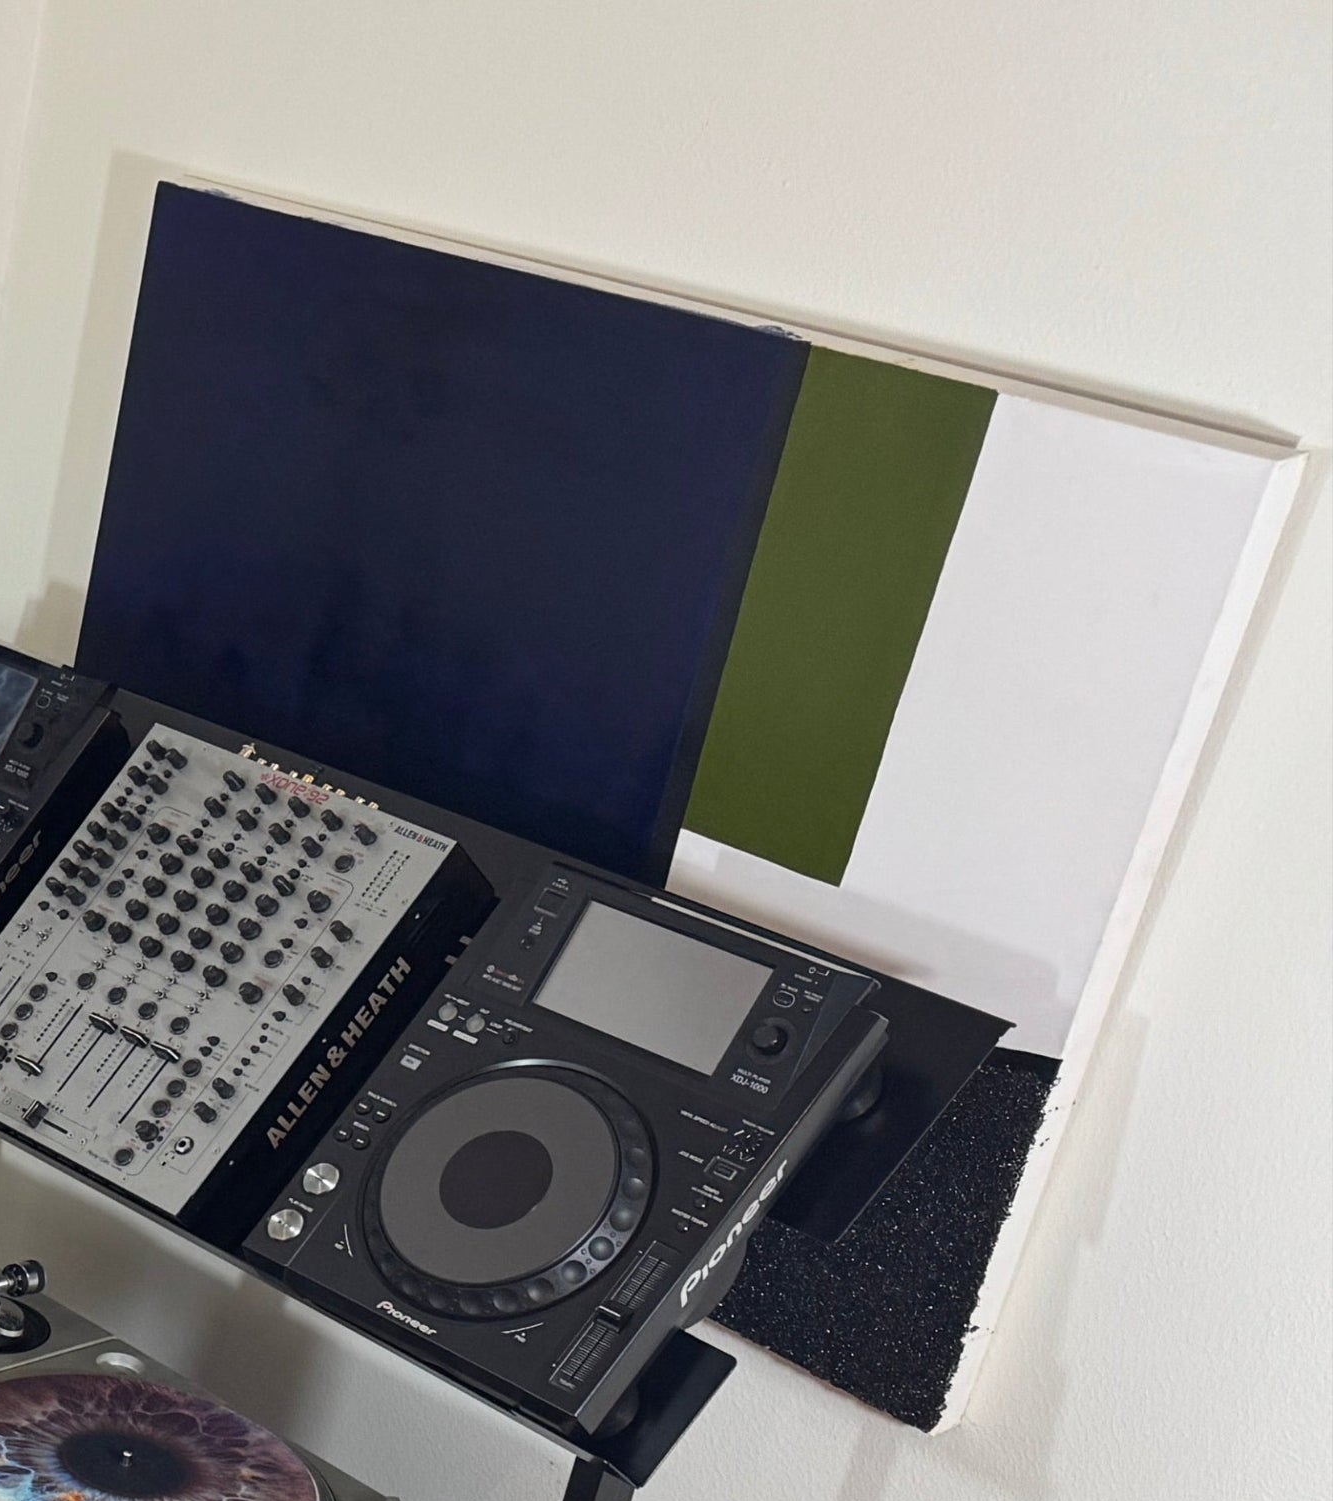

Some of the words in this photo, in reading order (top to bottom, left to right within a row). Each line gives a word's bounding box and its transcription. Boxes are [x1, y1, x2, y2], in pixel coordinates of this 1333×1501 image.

[266, 1064, 332, 1149] ALLEN
[326, 1045, 349, 1069] &
[340, 956, 412, 1048] HEATH
[730, 1072, 769, 1094] XDJ-1000
[680, 1159, 787, 1308] Pioneer
[376, 1300, 437, 1336] Pioneer
